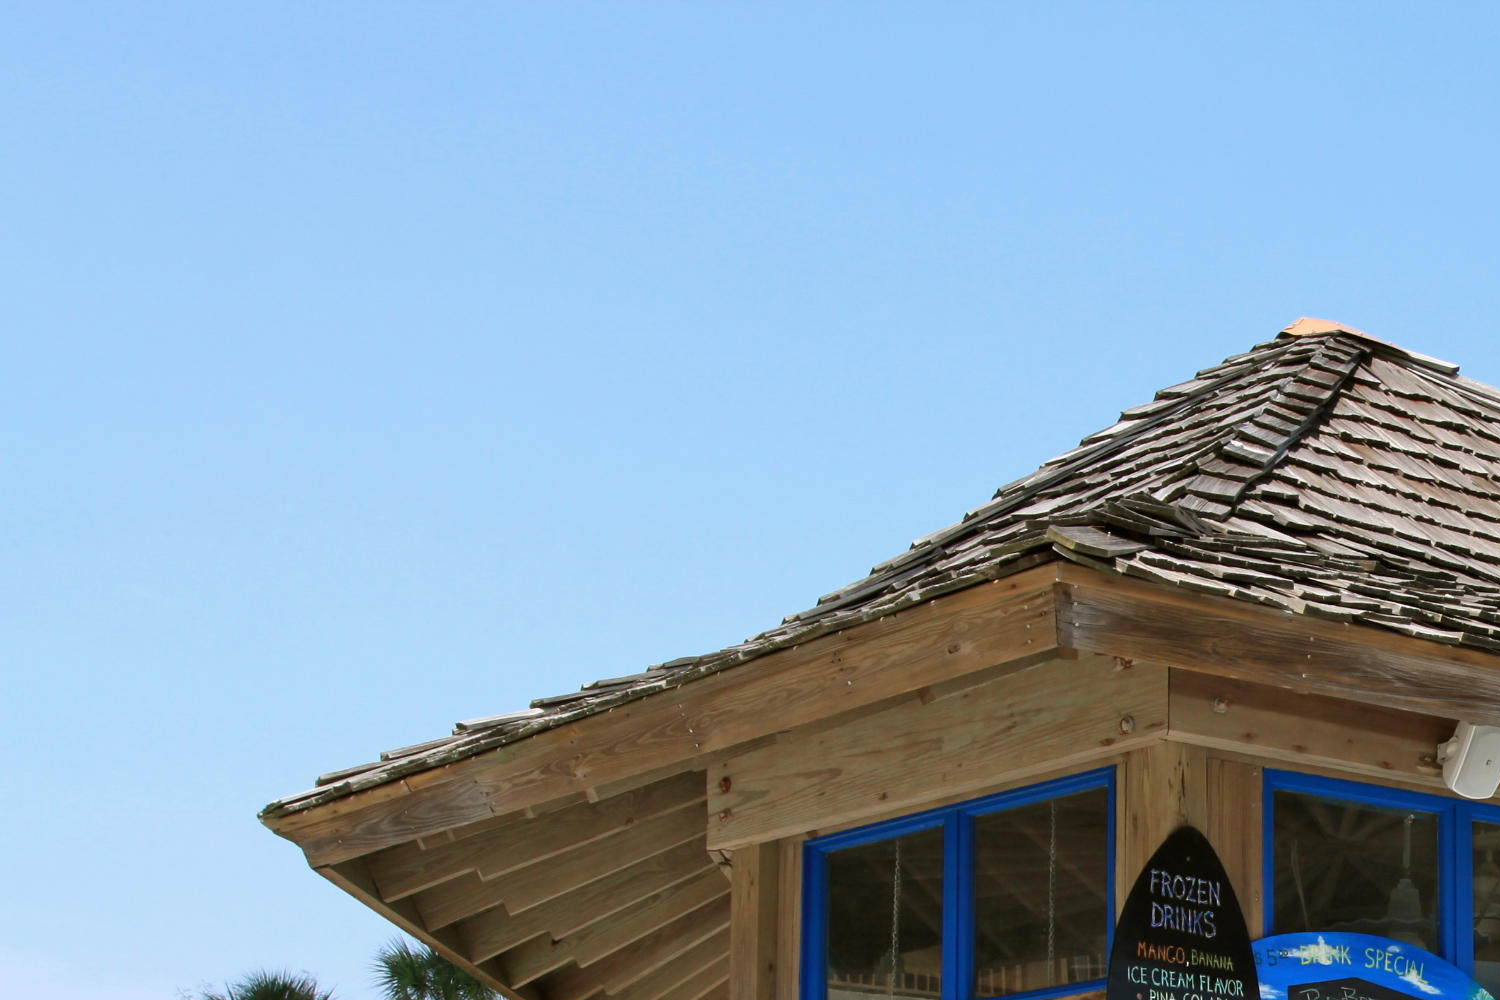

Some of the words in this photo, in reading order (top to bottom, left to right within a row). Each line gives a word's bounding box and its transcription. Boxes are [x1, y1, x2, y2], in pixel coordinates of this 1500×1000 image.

[1150, 868, 1221, 907] FROZEN
[1151, 901, 1217, 938] DRINKS
[1191, 949, 1234, 972] BANANA
[1364, 947, 1429, 985] SPECIAL
[1127, 966, 1148, 985] ICE
[1151, 967, 1195, 991] CREAM
[1200, 974, 1245, 998] FLAVOR
